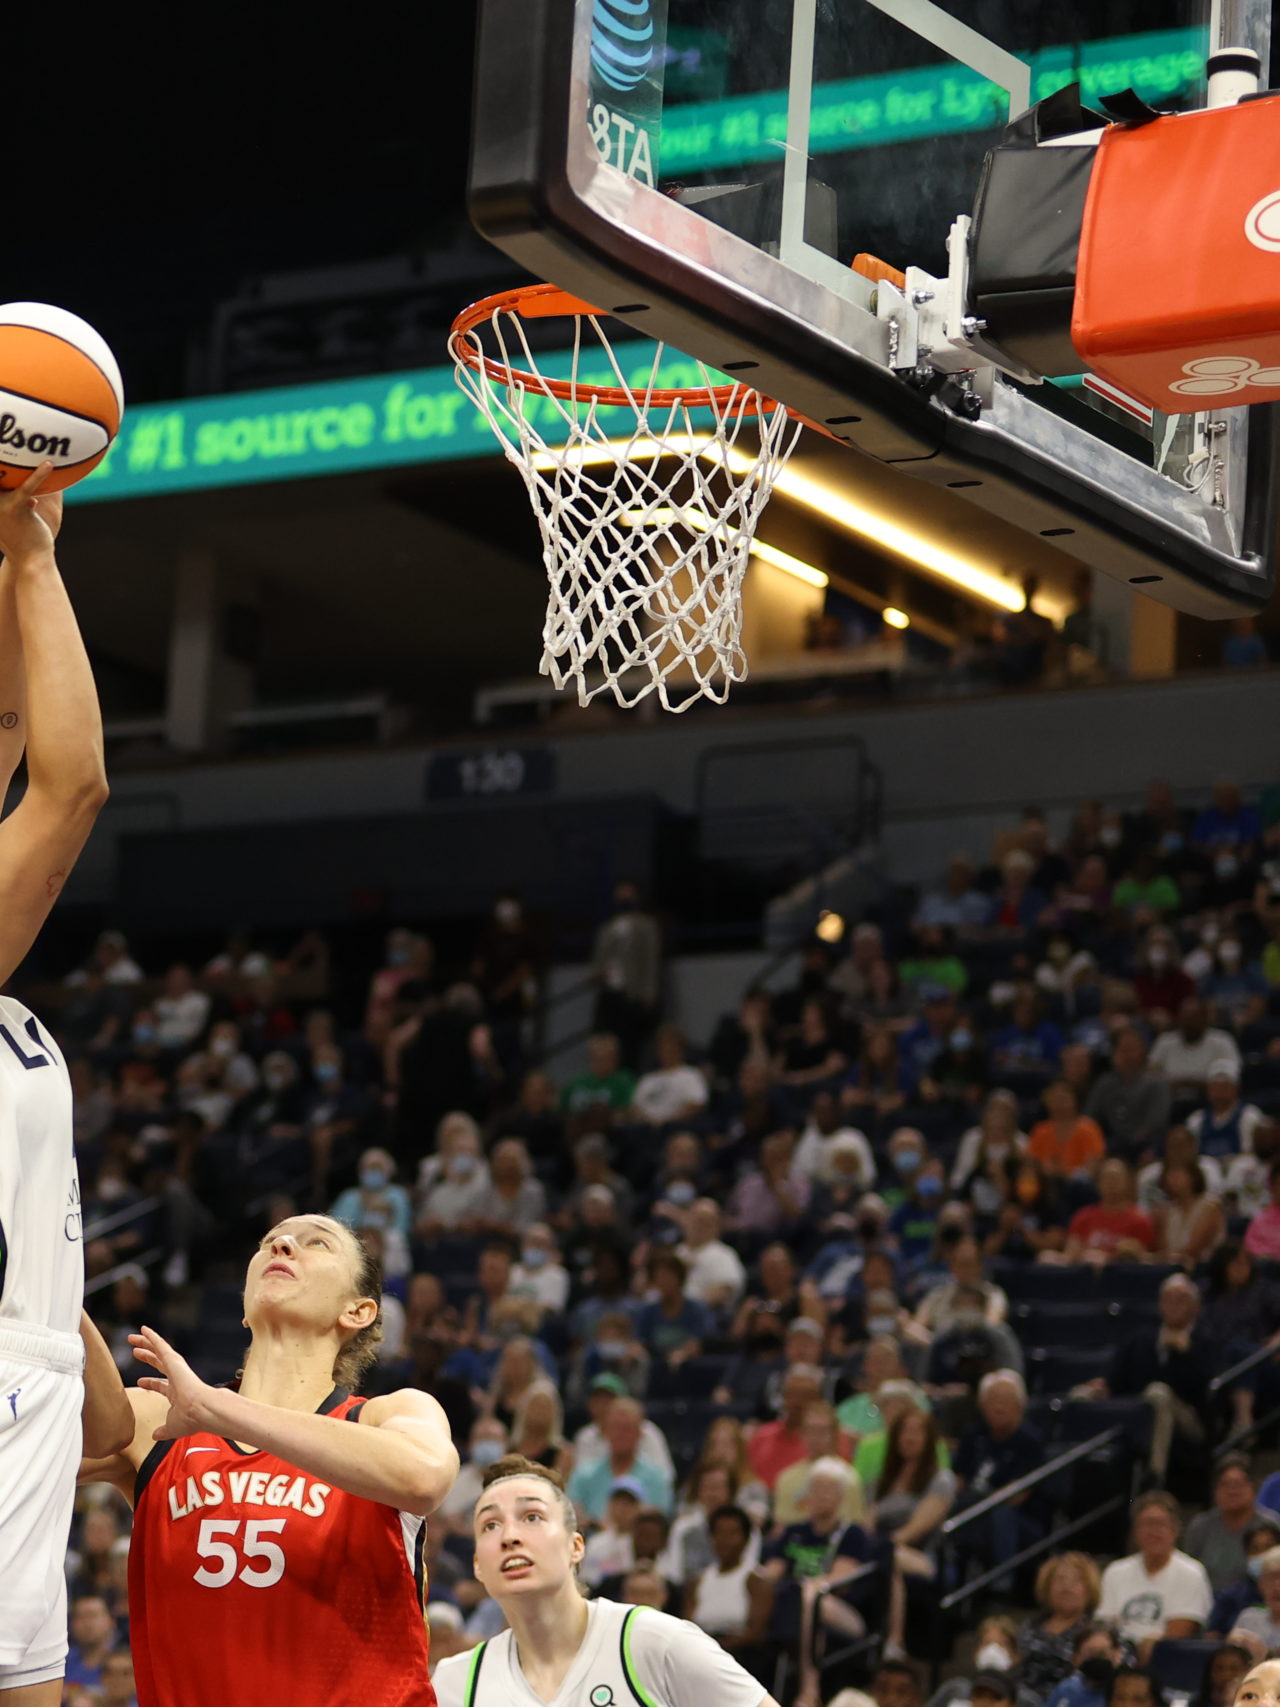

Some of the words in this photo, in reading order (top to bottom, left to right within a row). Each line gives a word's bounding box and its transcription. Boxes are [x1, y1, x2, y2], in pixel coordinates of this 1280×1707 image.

[127, 409, 187, 474] #1
[194, 402, 376, 466] source
[383, 382, 459, 443] for
[168, 1470, 225, 1521] LAS
[228, 1471, 332, 1518] VEGAS
[193, 1518, 287, 1589] 55
